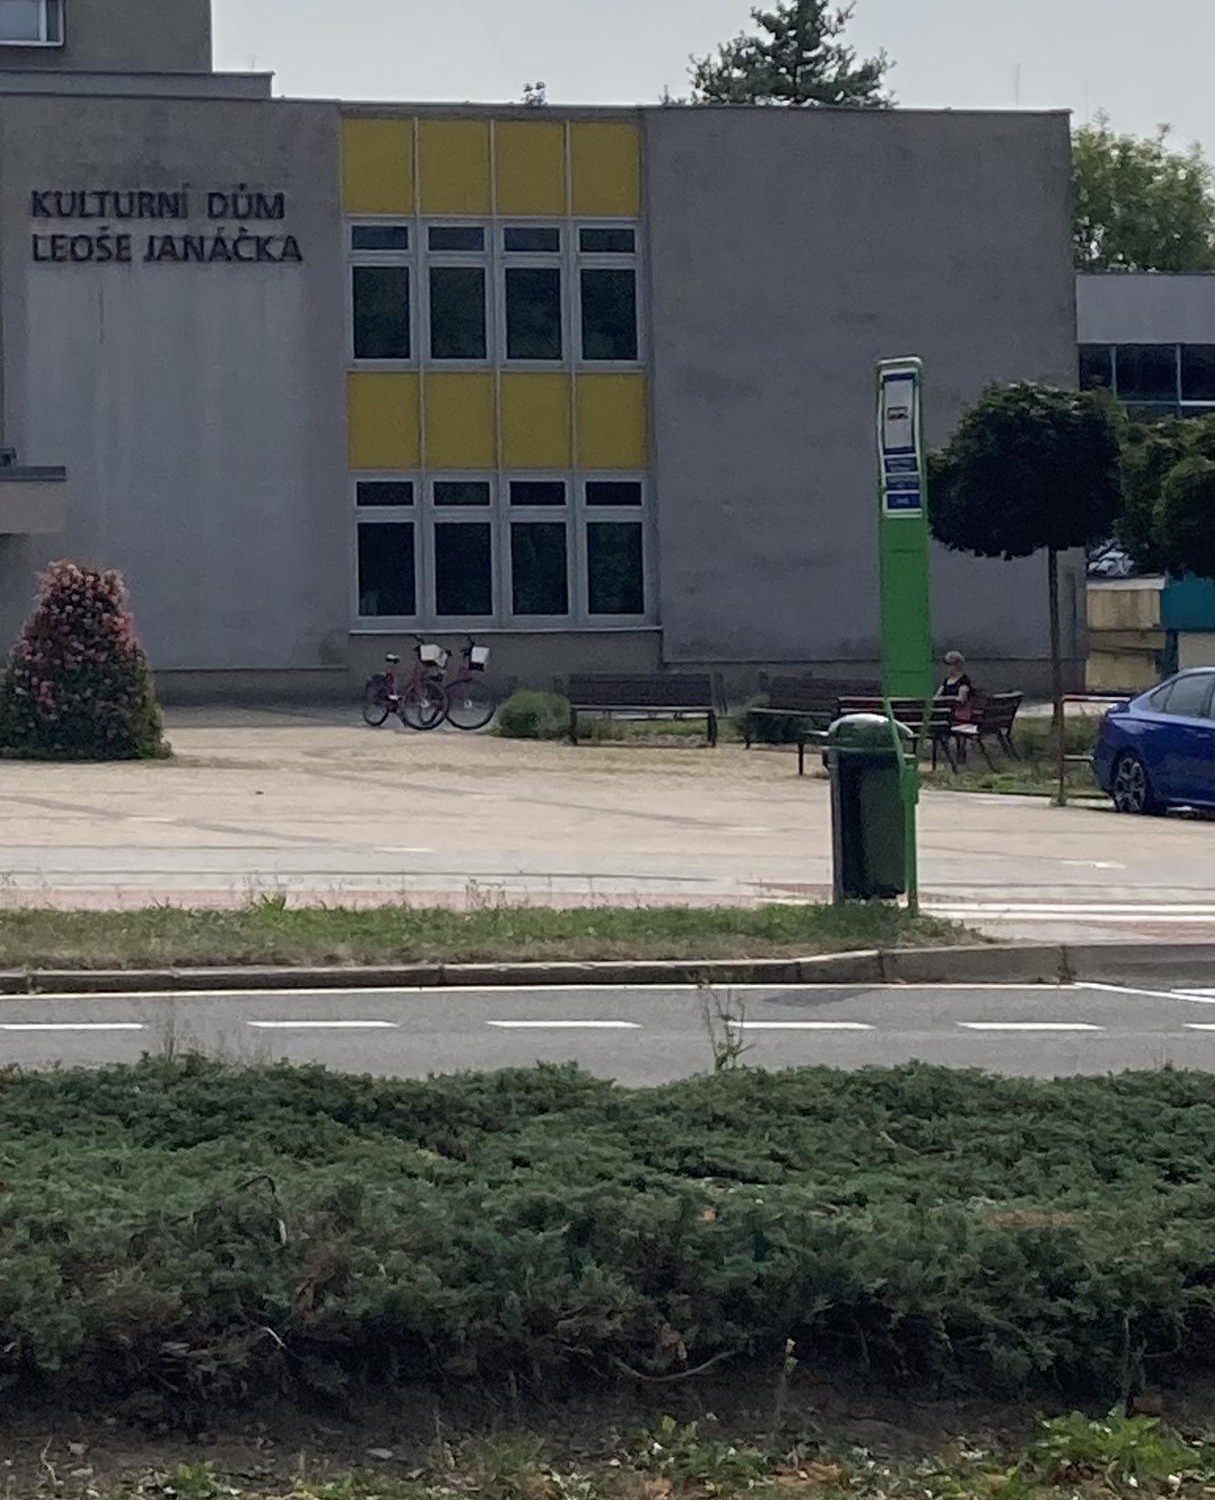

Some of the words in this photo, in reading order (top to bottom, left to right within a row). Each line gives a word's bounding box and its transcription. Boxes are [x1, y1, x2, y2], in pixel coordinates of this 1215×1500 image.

[31, 183, 191, 219] KULTURNÍ
[207, 183, 285, 219] DŮM
[32, 225, 132, 262] LEOŠE
[143, 225, 304, 262] JANÁČKA
